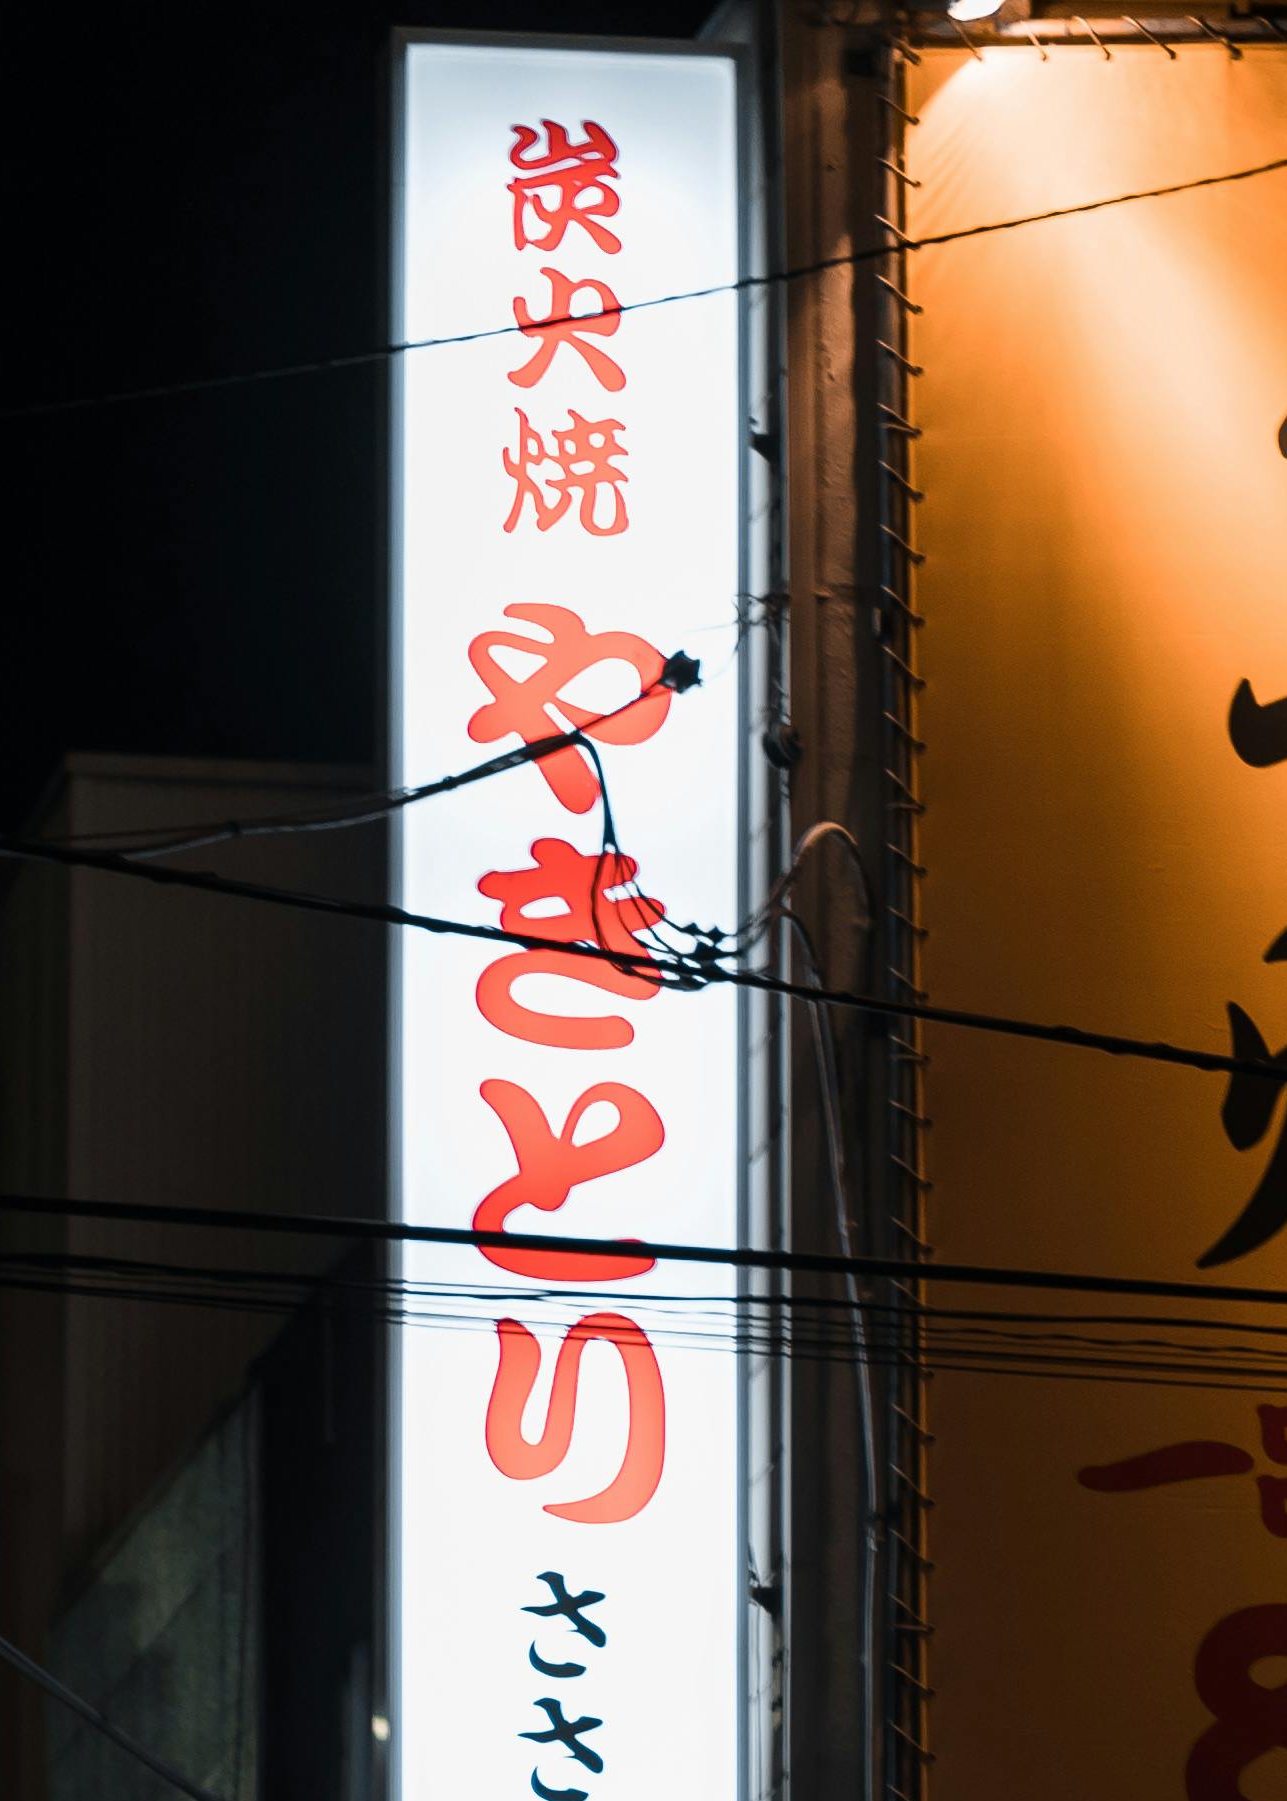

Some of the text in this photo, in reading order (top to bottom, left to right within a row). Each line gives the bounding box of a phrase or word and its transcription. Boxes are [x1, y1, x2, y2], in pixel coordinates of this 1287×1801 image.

[502, 119, 629, 536] 炭火焼
[467, 602, 671, 1525] やきとり
